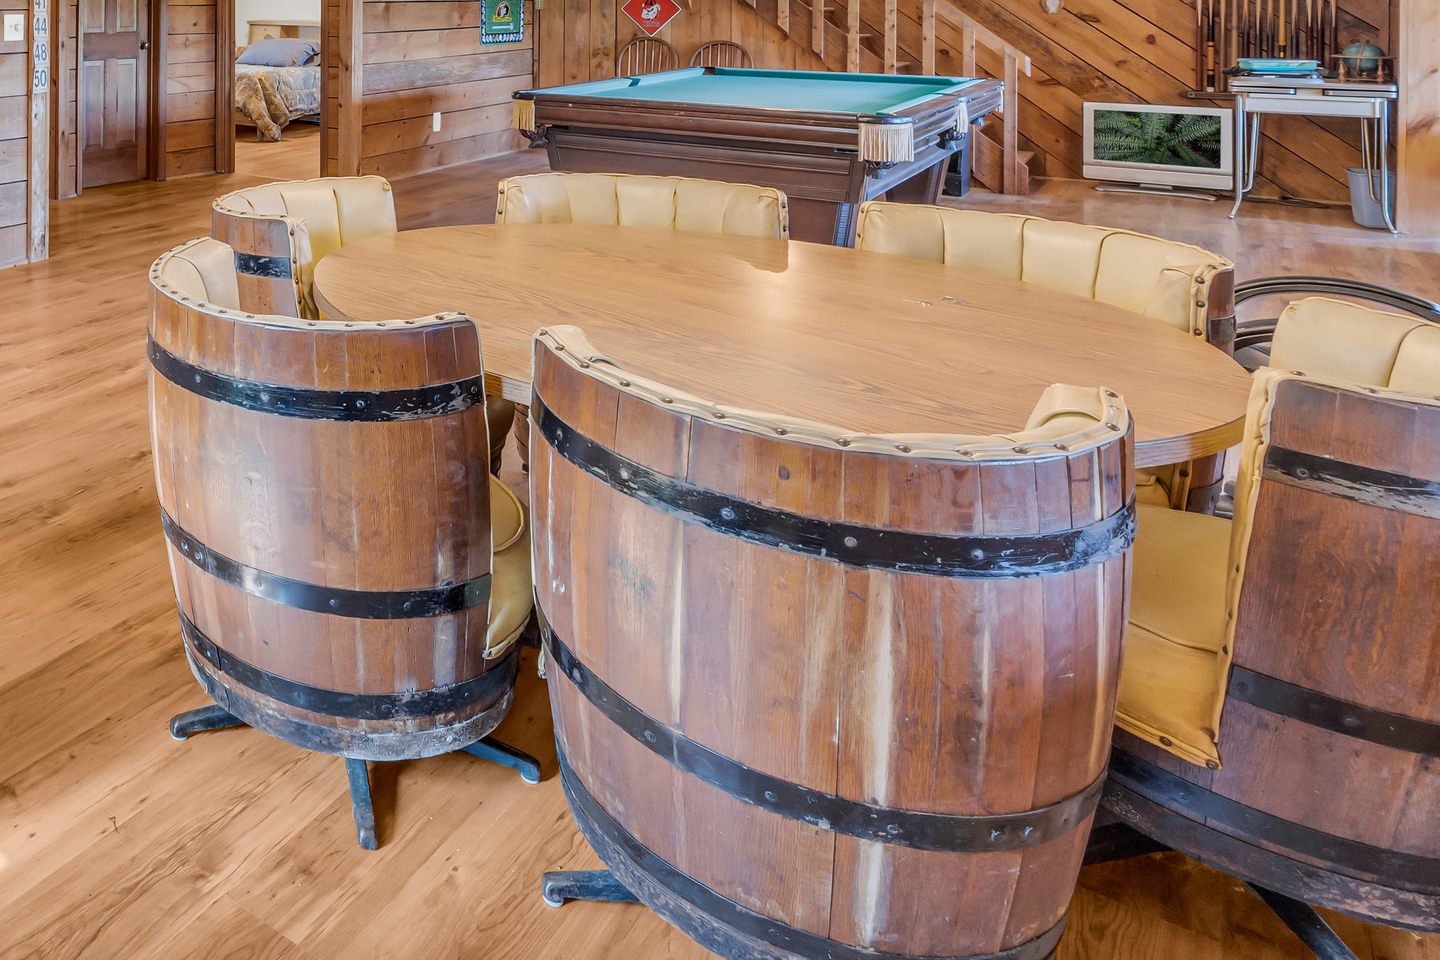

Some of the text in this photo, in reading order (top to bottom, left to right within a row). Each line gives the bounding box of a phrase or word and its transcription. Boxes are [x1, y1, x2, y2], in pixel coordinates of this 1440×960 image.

[34, 17, 47, 35] 44
[34, 43, 47, 62] 48
[34, 69, 47, 87] 50
